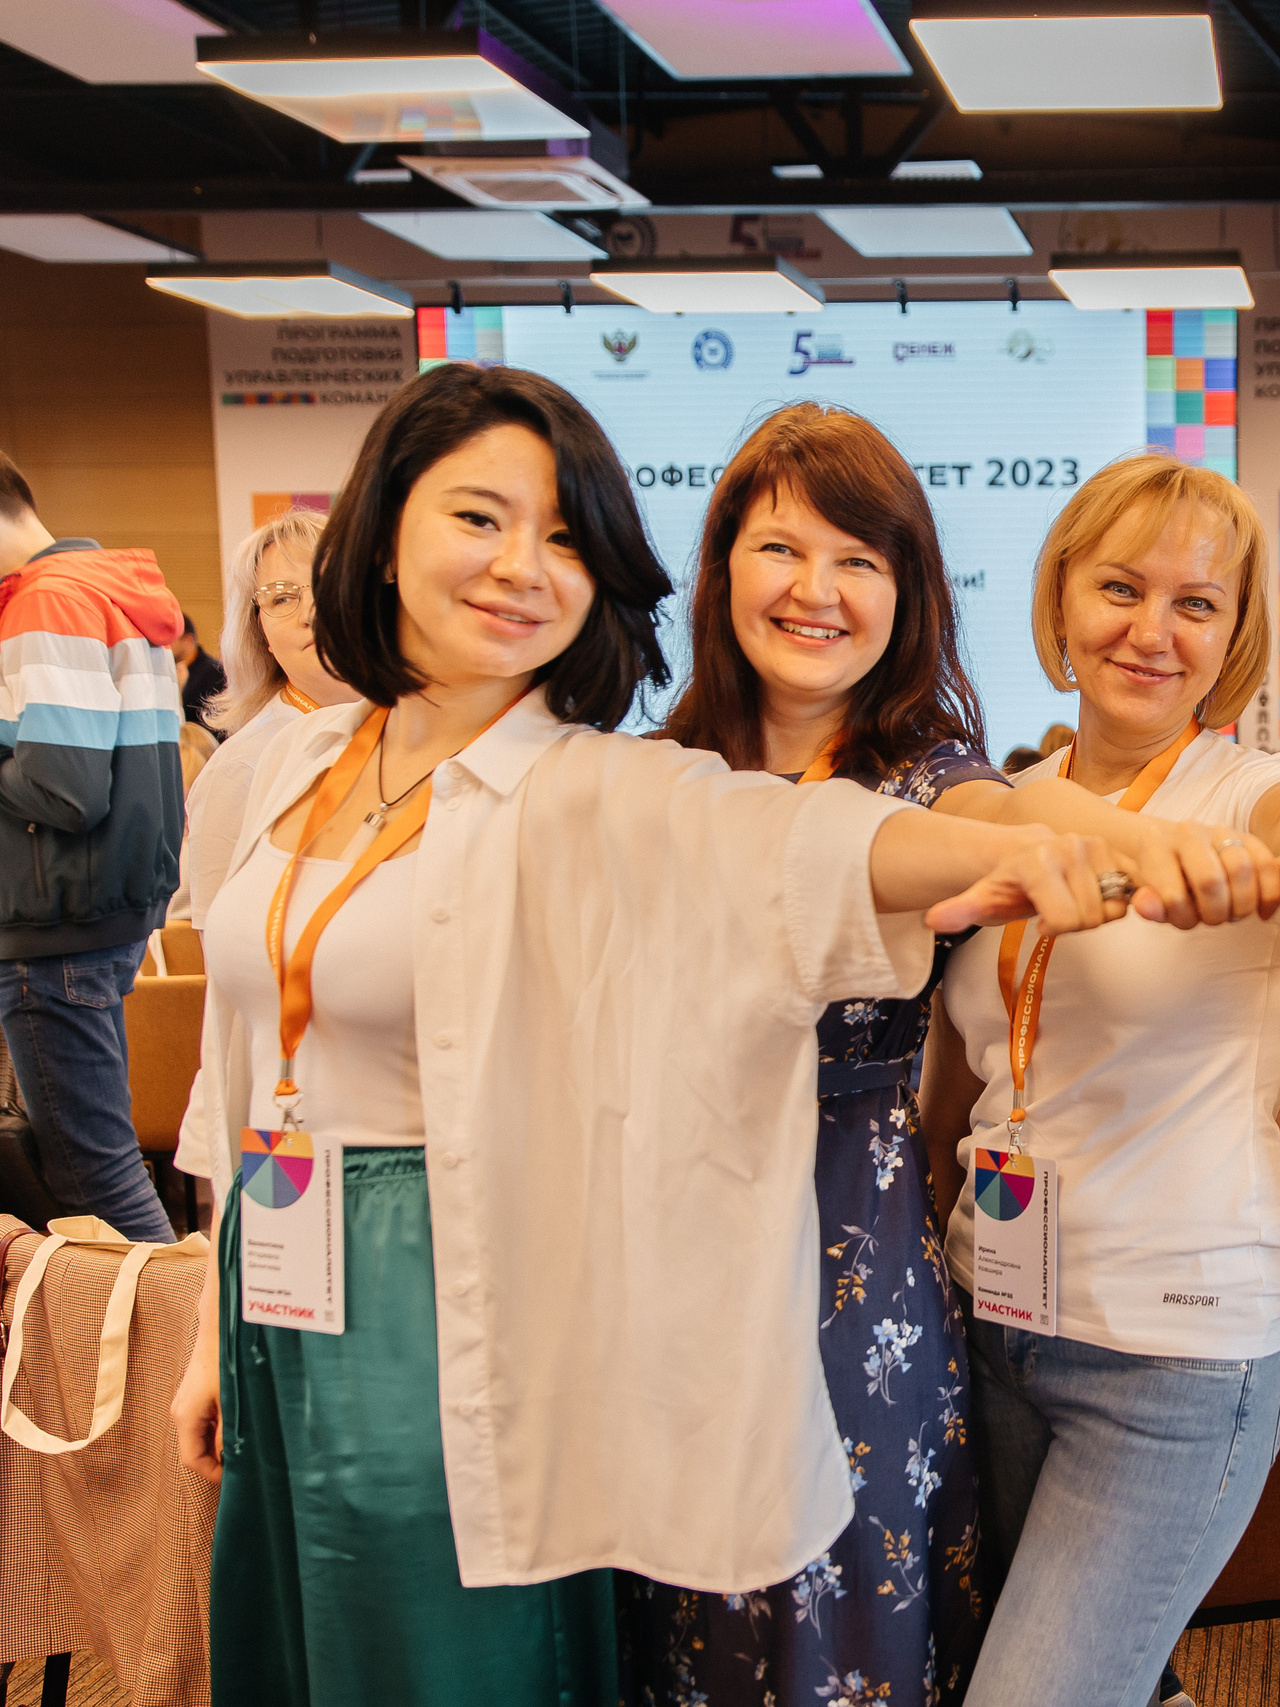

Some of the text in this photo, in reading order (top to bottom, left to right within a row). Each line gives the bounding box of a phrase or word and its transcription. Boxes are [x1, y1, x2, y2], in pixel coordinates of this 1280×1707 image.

[277, 325, 401, 340] ПРОГРАММА
[320, 392, 393, 405] КОМАН
[987, 459, 1078, 486] 2023
[1162, 1292, 1221, 1307] BARSSPORT
[248, 1299, 316, 1320] УЧАСТНИК
[978, 1299, 1033, 1322] УЧАСТНИК
